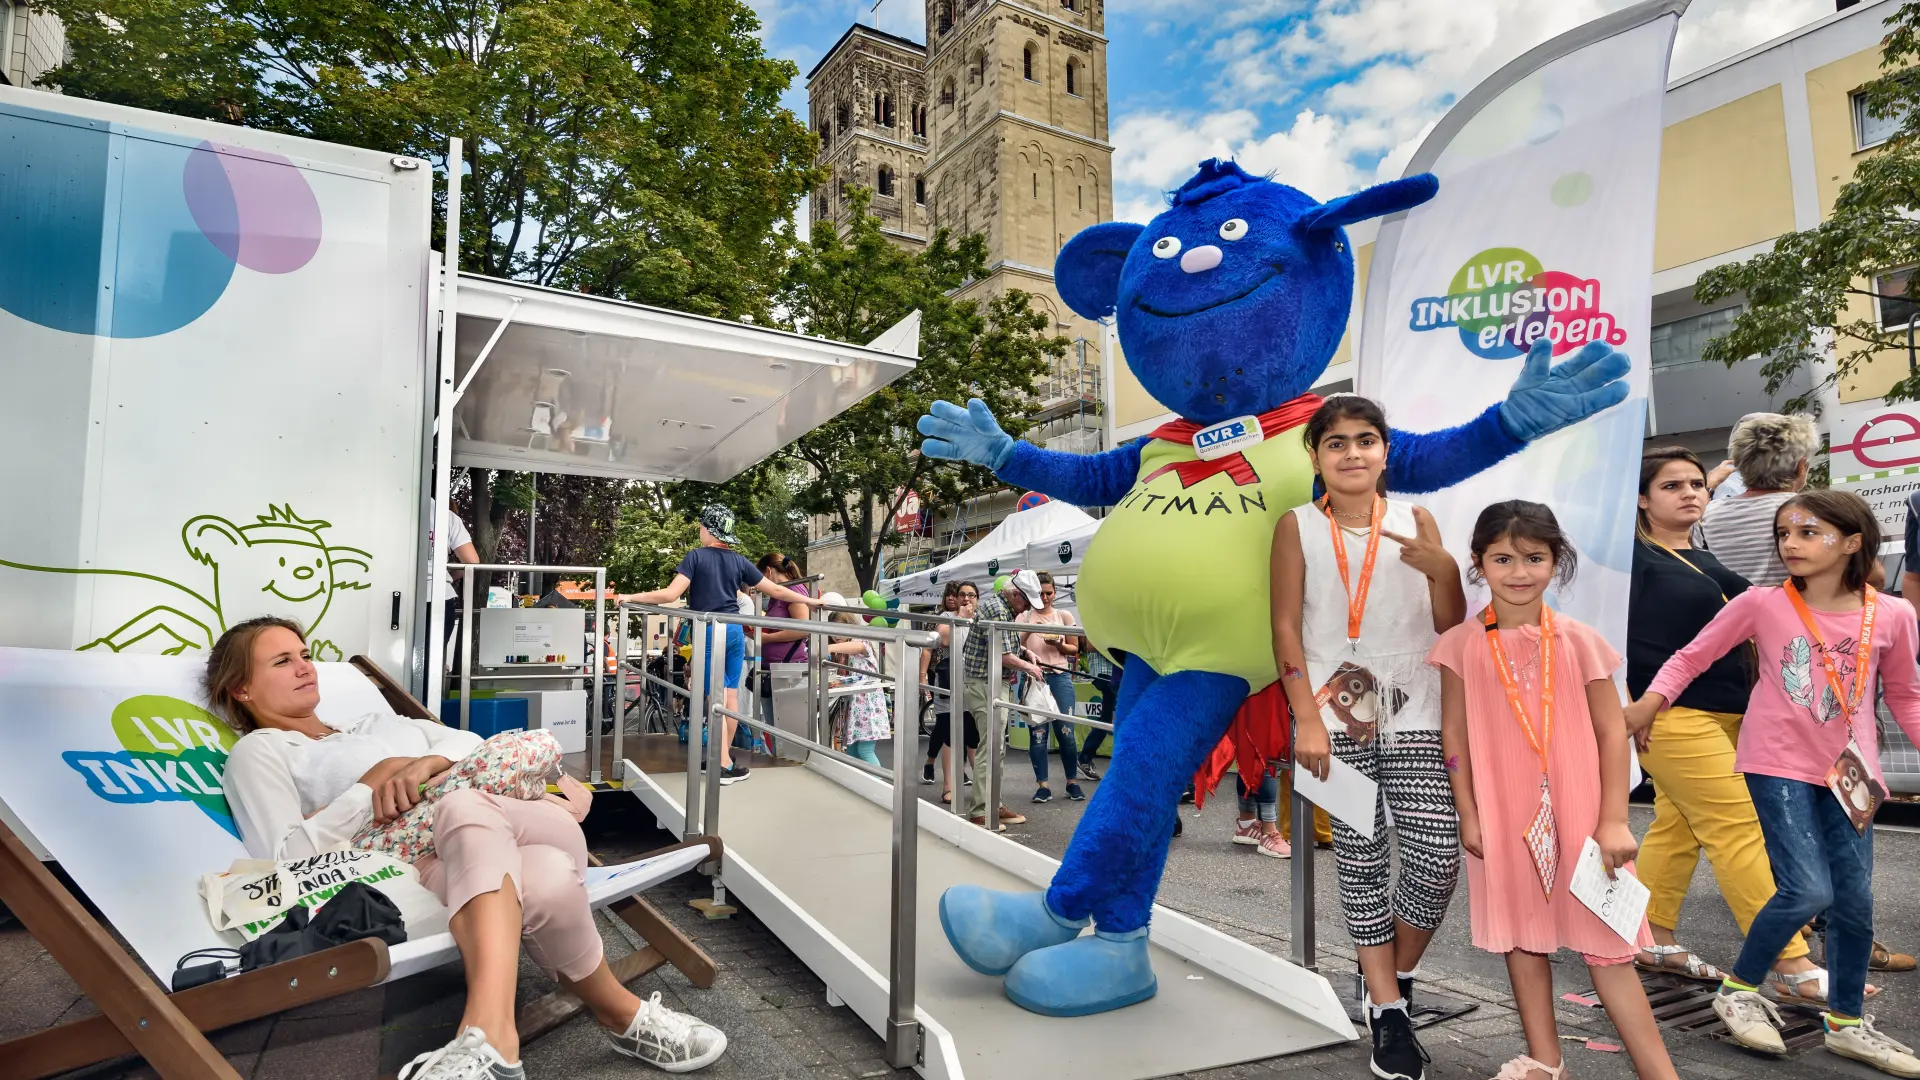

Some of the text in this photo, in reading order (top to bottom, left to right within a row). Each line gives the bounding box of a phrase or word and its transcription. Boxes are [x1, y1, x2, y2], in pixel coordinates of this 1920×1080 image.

[1467, 260, 1533, 289] LVR.
[1416, 285, 1593, 326] INKLUSION
[1478, 315, 1621, 348] erleben.
[1200, 427, 1234, 445] LVR
[1200, 444, 1221, 453] Qualität
[1232, 433, 1260, 444] Menschen
[1861, 601, 1874, 644] IKEA FAMILY
[1085, 703, 1102, 716] VRS
[130, 717, 229, 755] LVR
